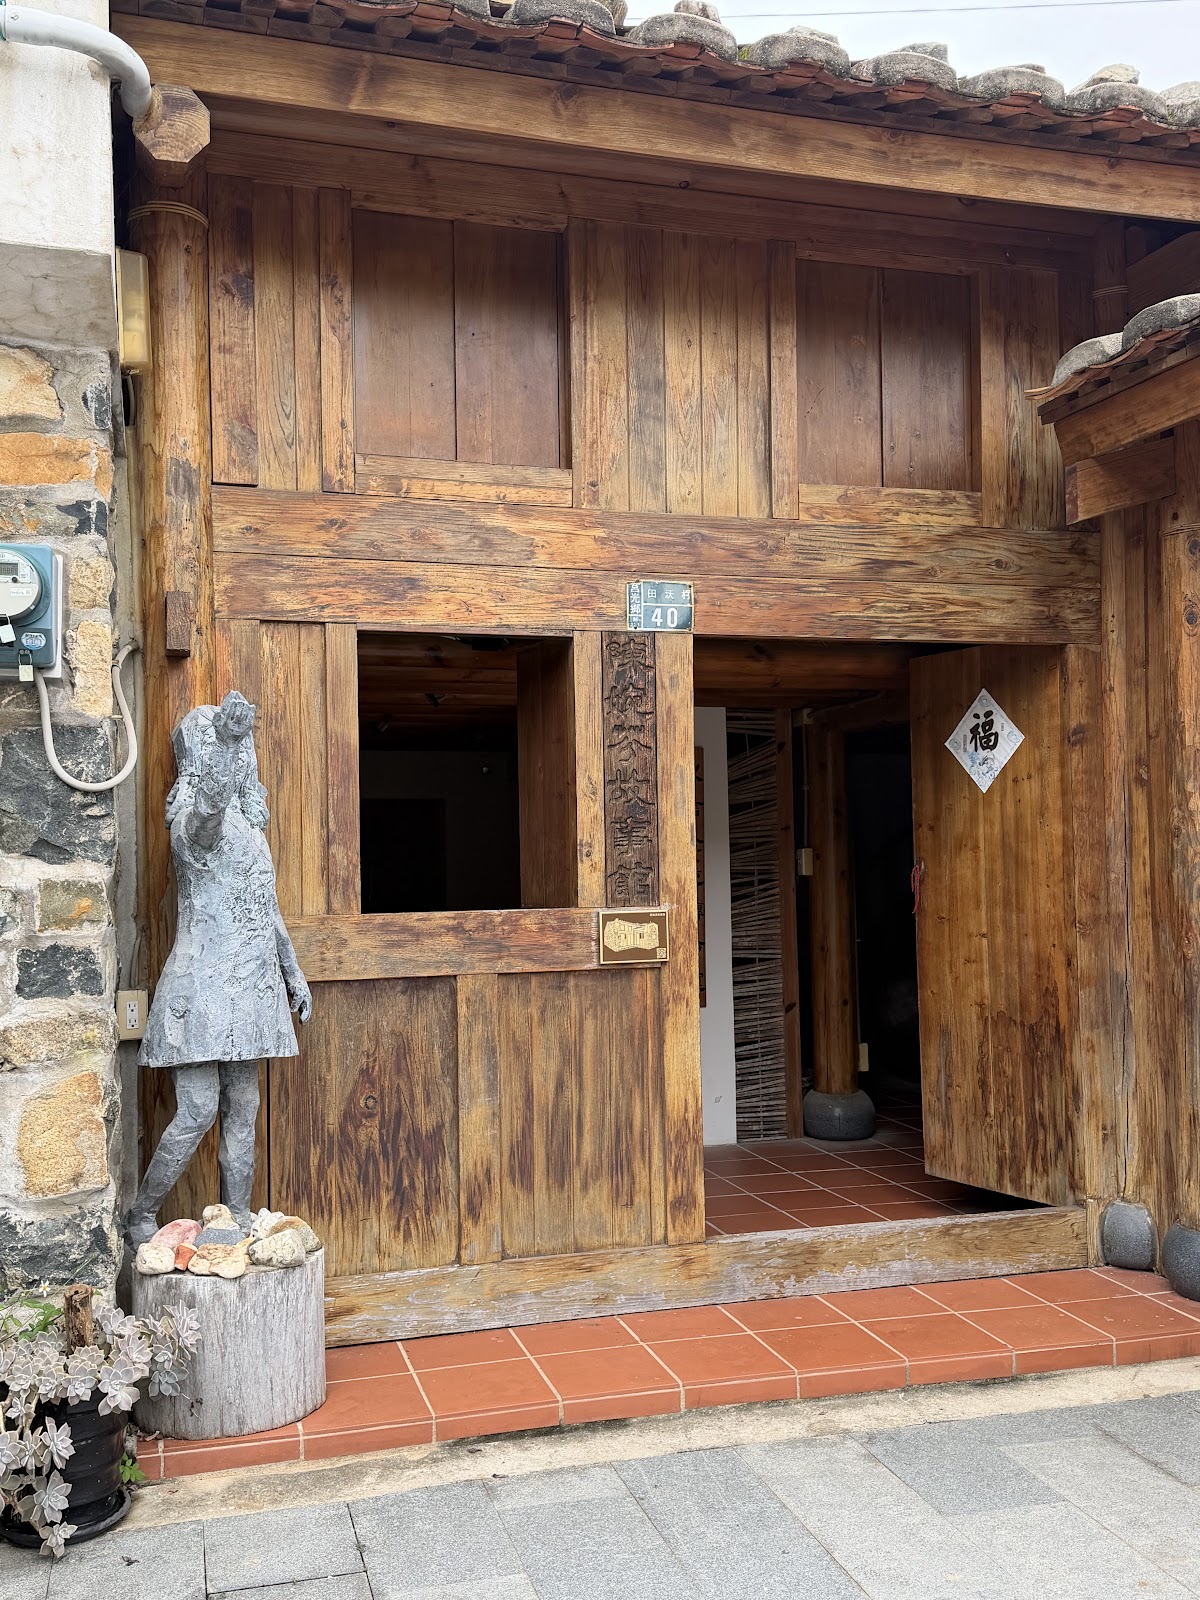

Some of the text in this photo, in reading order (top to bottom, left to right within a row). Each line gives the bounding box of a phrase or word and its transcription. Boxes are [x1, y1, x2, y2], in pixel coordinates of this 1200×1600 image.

[647, 588, 691, 600] 田沃村
[651, 607, 678, 628] 40
[969, 709, 999, 753] 福
